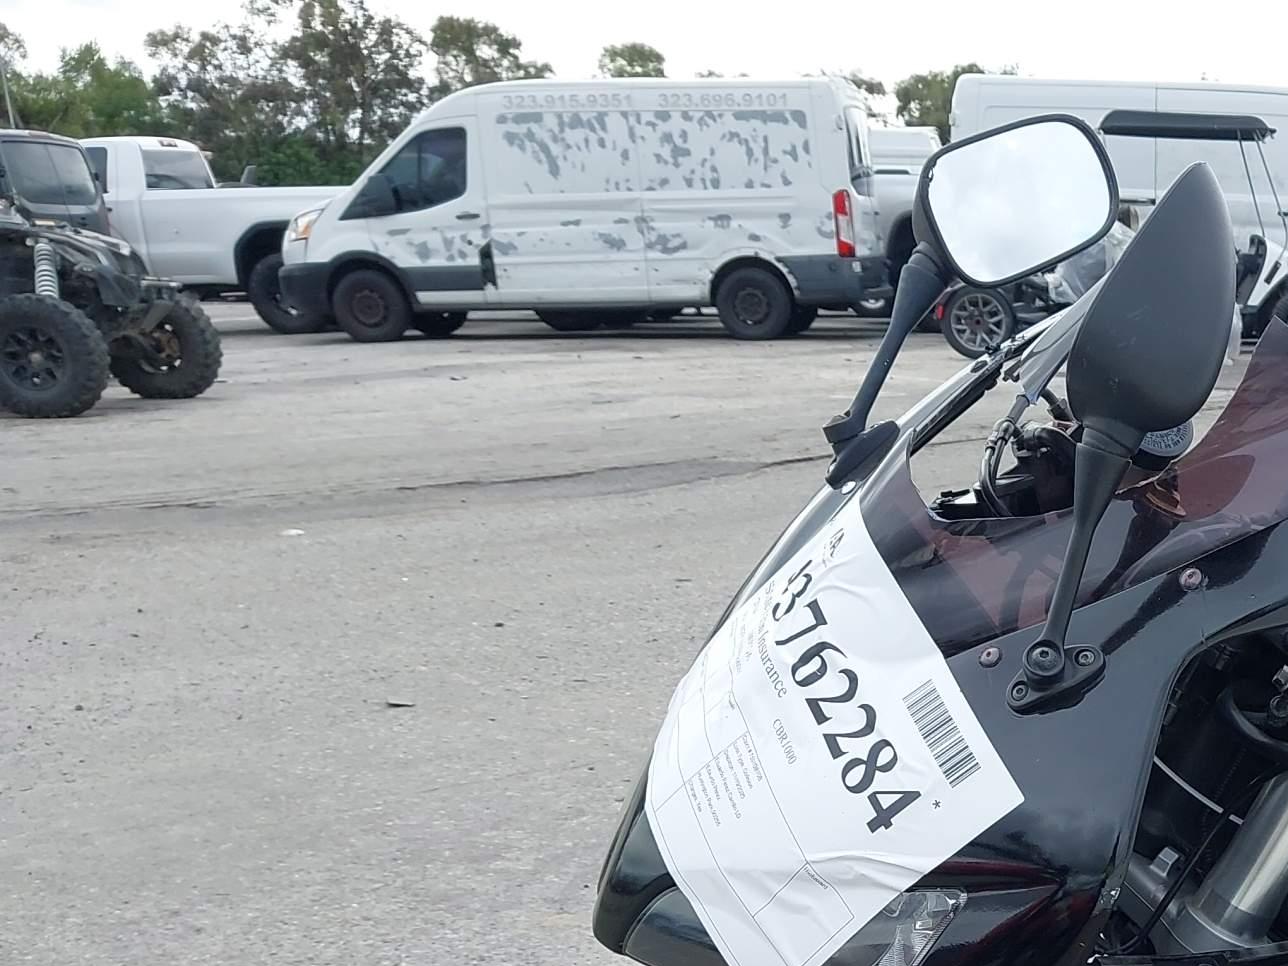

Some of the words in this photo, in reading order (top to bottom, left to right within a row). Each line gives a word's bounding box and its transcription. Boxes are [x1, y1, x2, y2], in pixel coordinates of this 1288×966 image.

[502, 95, 633, 109] 323.915.9351
[658, 93, 789, 108] 323.696.9101
[756, 625, 788, 699] Insurance
[772, 718, 798, 765] CBR1000
